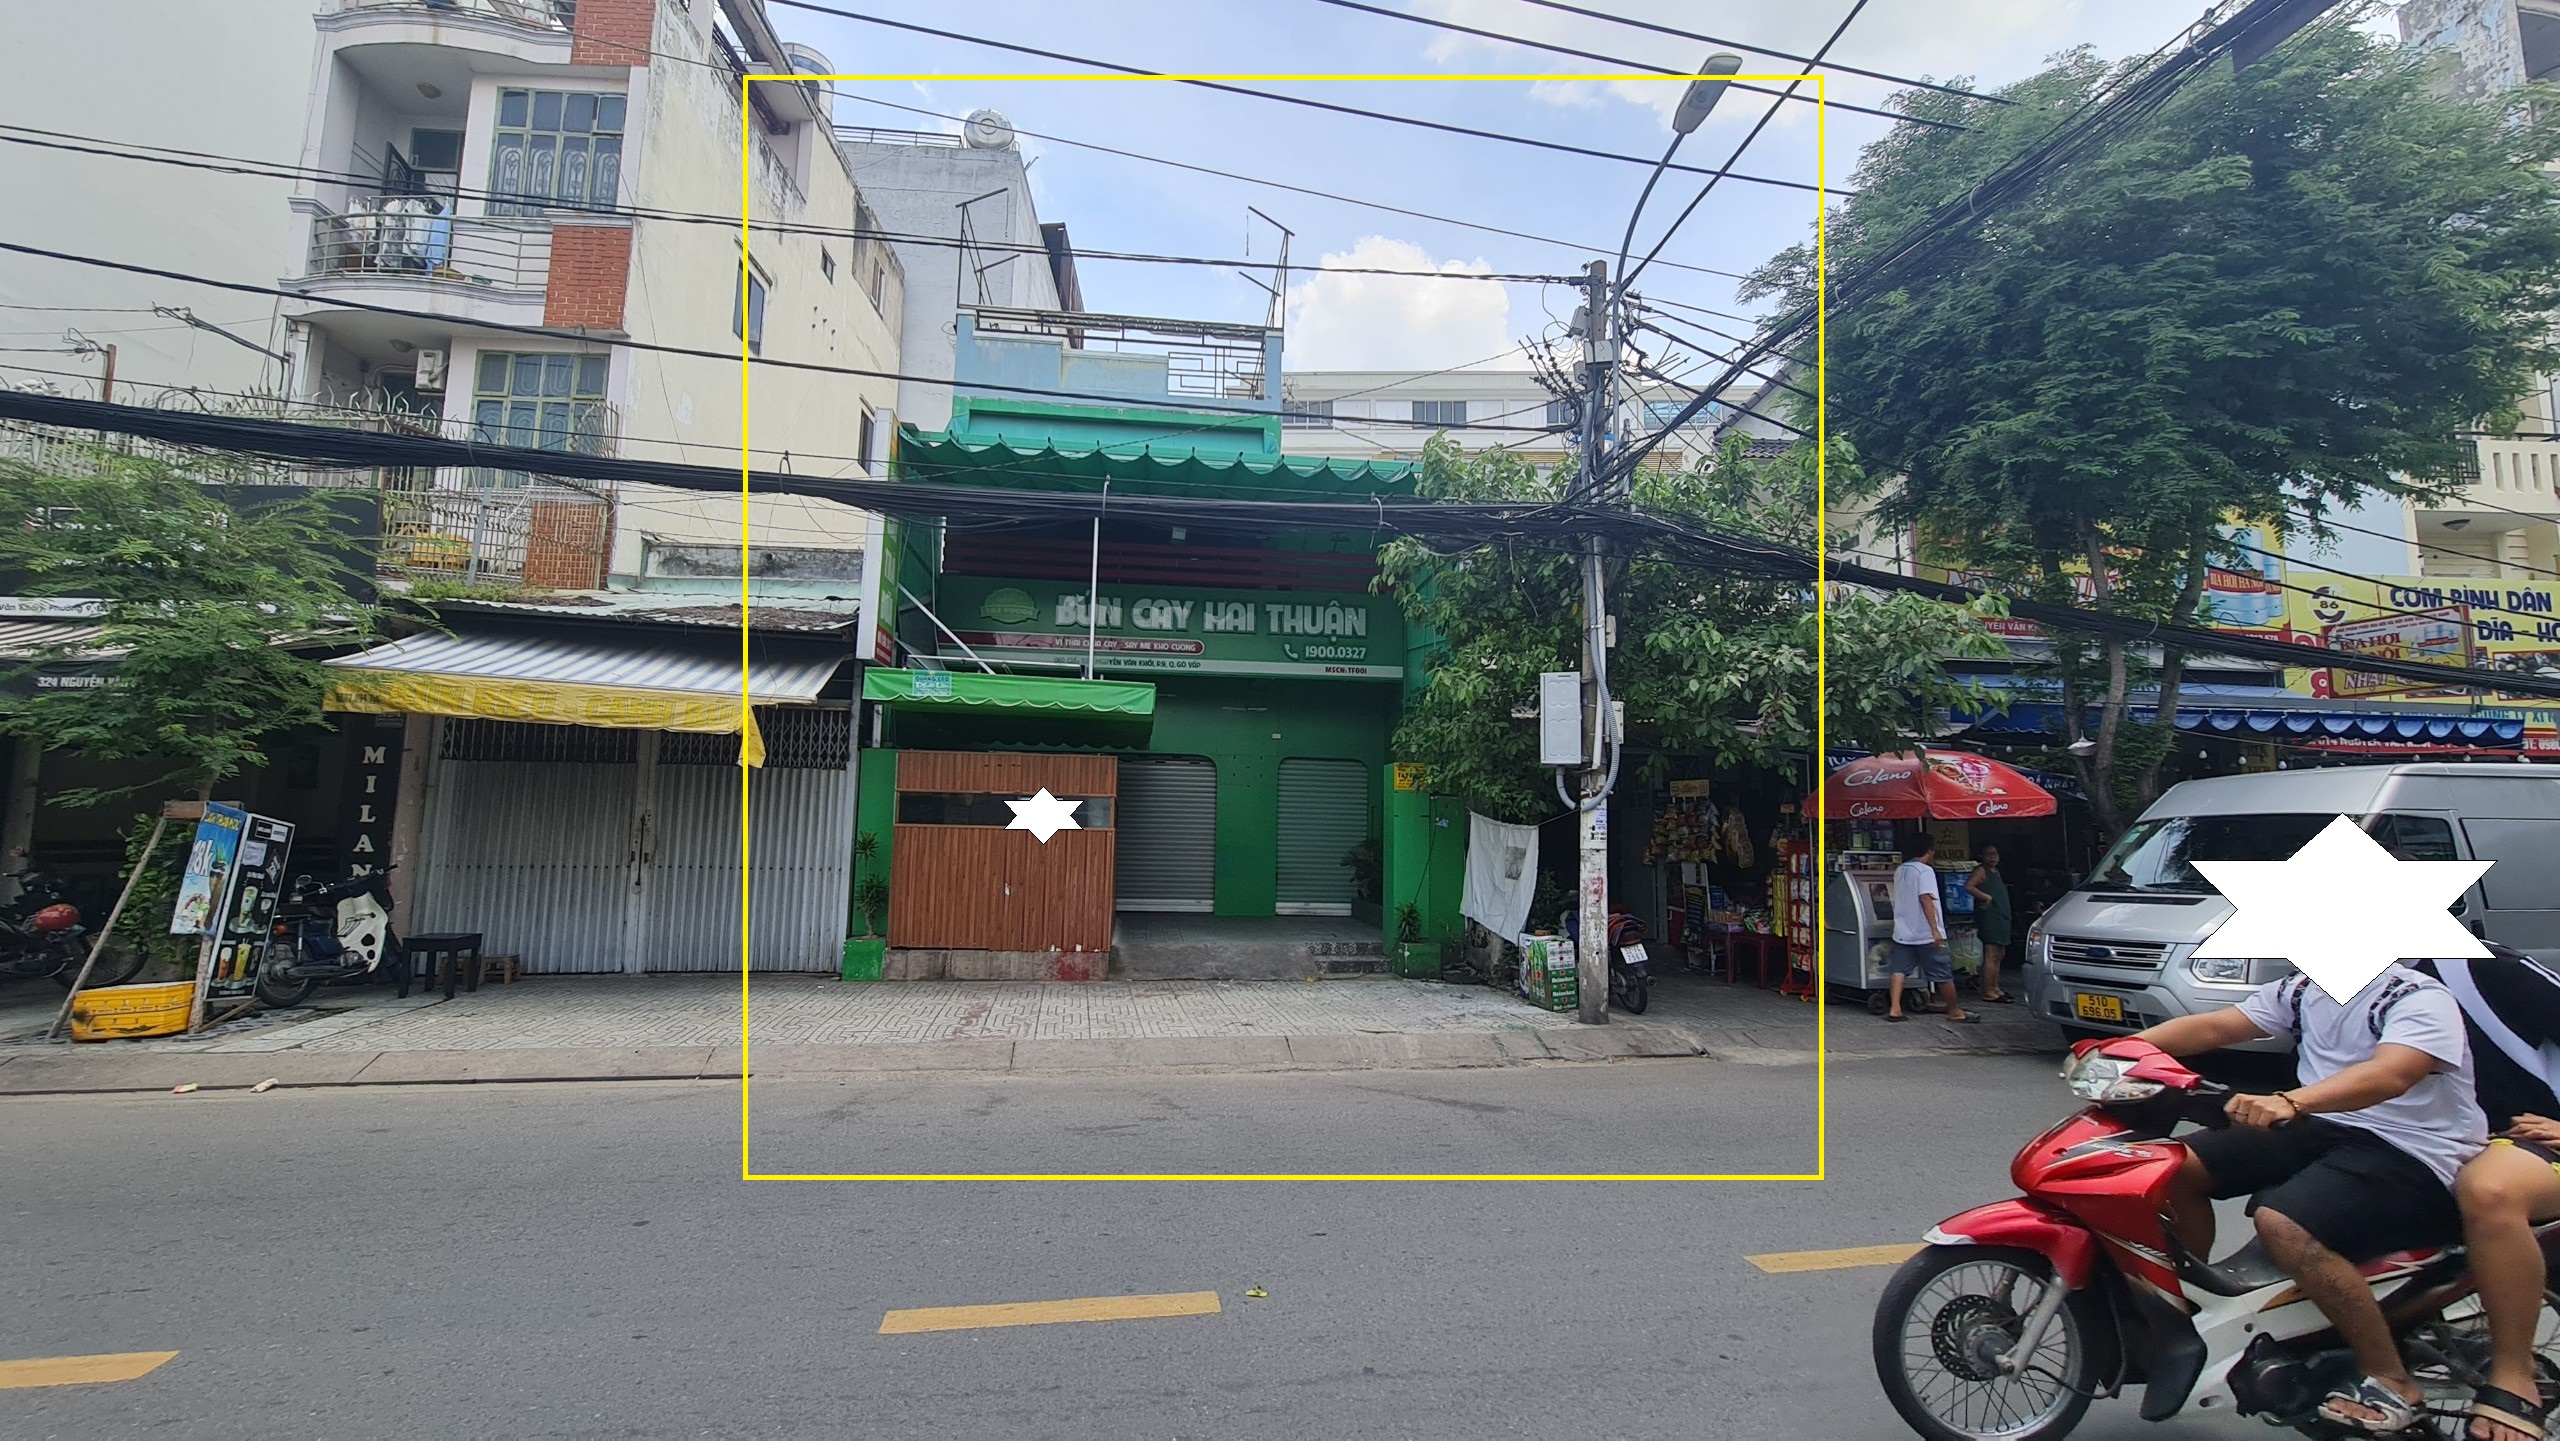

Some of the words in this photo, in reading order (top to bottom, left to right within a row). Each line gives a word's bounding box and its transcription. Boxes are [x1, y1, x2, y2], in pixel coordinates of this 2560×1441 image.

[2320, 600, 2339, 609] 86
[2506, 586, 2553, 612] DÂN
[1055, 589, 1123, 628] BÚN
[1132, 598, 1194, 630] CAY
[1203, 601, 1255, 632] HAI
[1266, 600, 1367, 642] THUẬN
[2477, 617, 2514, 642] ĐĨA
[1305, 644, 1367, 659] 1900.0327
[38, 676, 57, 688] 324
[472, 682, 556, 720] RIÊU
[585, 696, 676, 728] CANH
[1843, 768, 1912, 787] Celano
[1849, 801, 1885, 817] Celano
[1976, 799, 2009, 816] Celano
[2089, 995, 2108, 1007] 51D
[2082, 1005, 2117, 1019] 696.05
